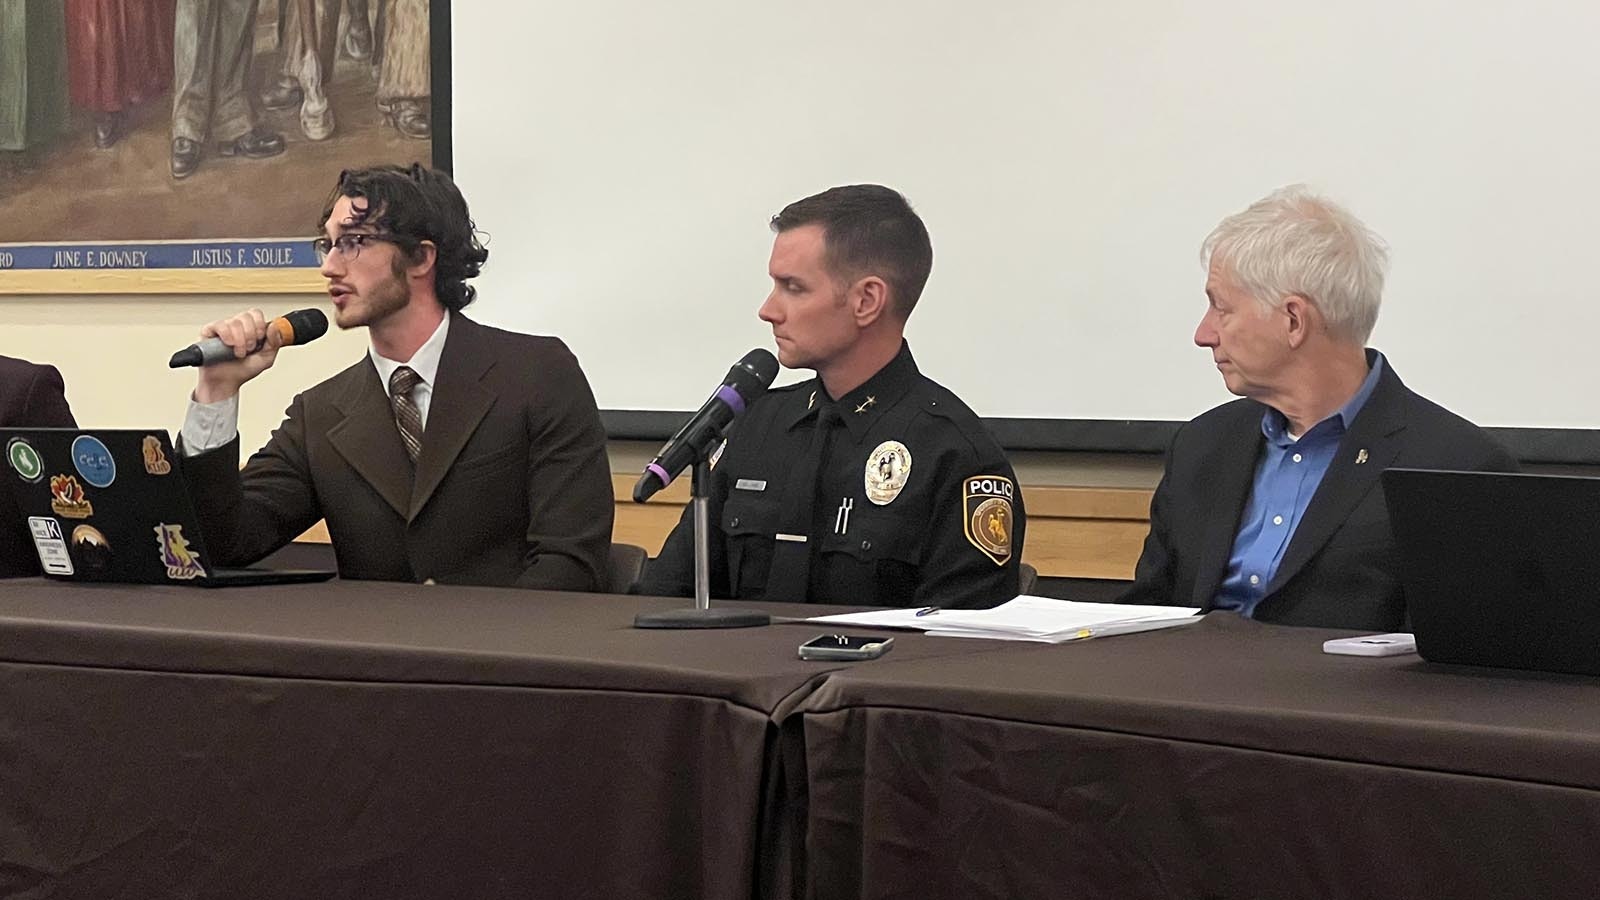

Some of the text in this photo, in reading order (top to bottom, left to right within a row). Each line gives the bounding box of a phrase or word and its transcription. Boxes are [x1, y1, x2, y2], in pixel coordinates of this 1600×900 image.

[53, 251, 81, 267] JUNE
[100, 251, 148, 267] DOWNEY
[190, 248, 293, 266] JUSTUS F. SOULE
[47, 521, 60, 538] K
